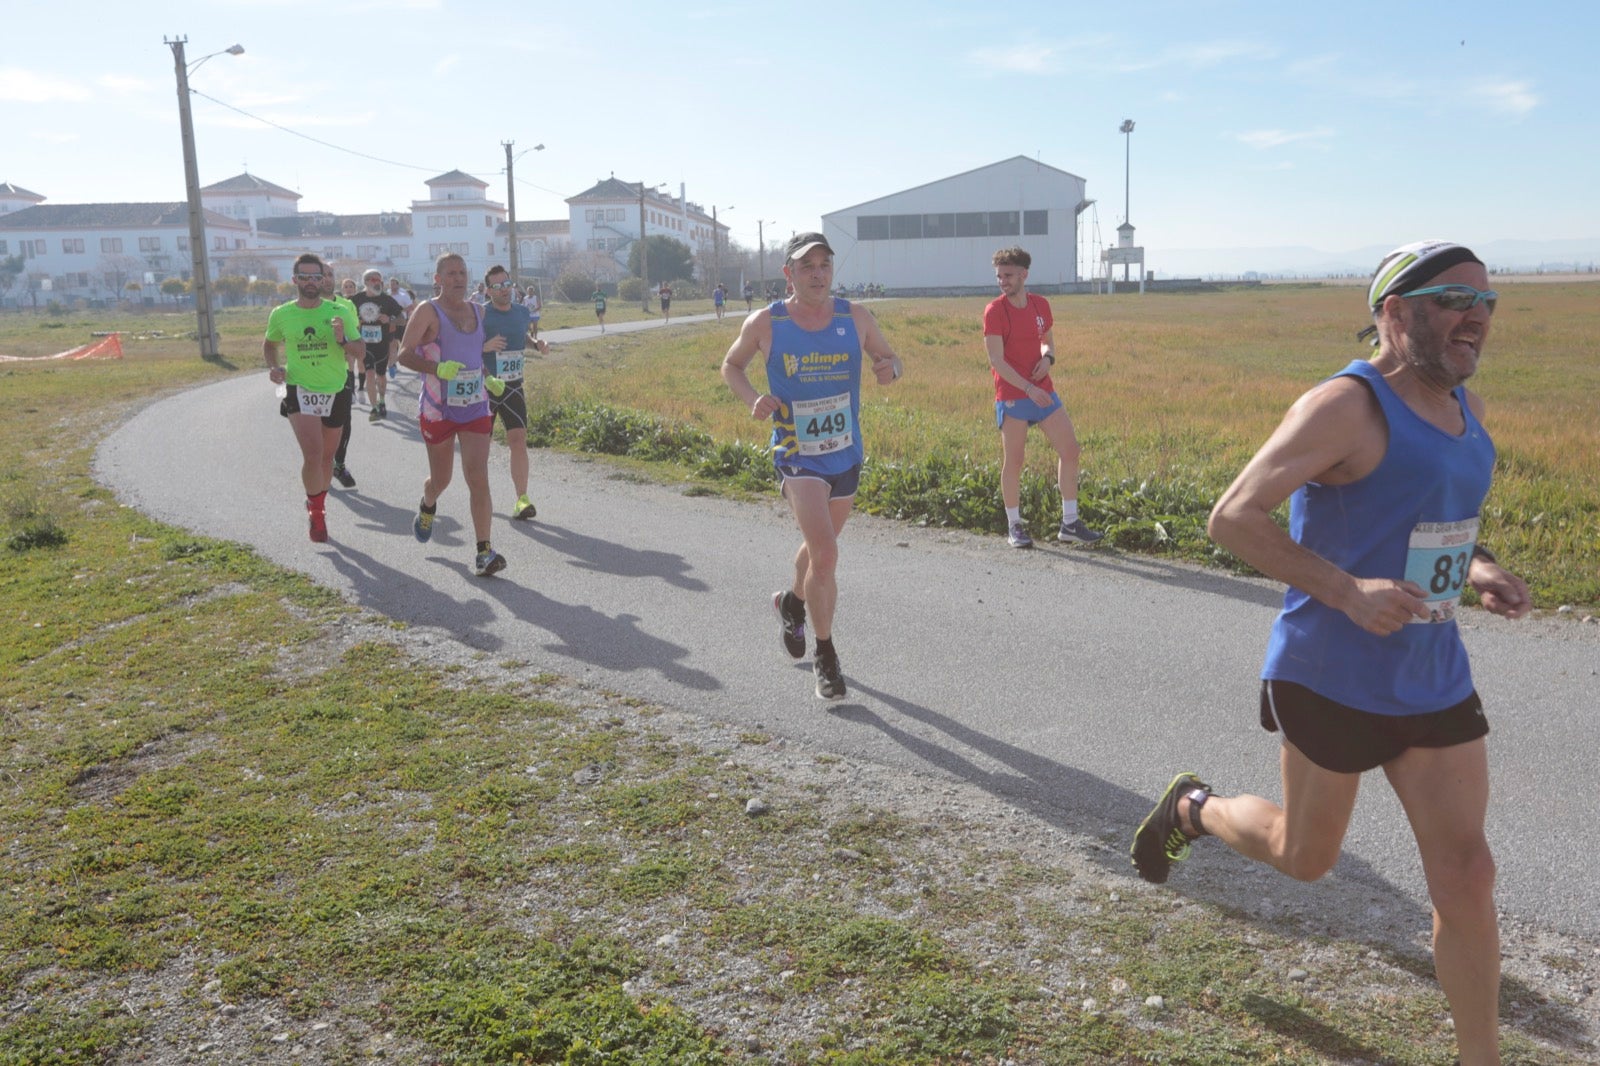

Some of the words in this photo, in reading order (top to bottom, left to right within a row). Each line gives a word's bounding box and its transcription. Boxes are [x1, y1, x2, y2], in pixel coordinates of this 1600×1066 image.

[802, 352, 849, 364] olimpo
[502, 360, 521, 372] 286
[302, 394, 332, 406] 3037
[806, 412, 846, 437] 449
[1430, 552, 1467, 594] 83
